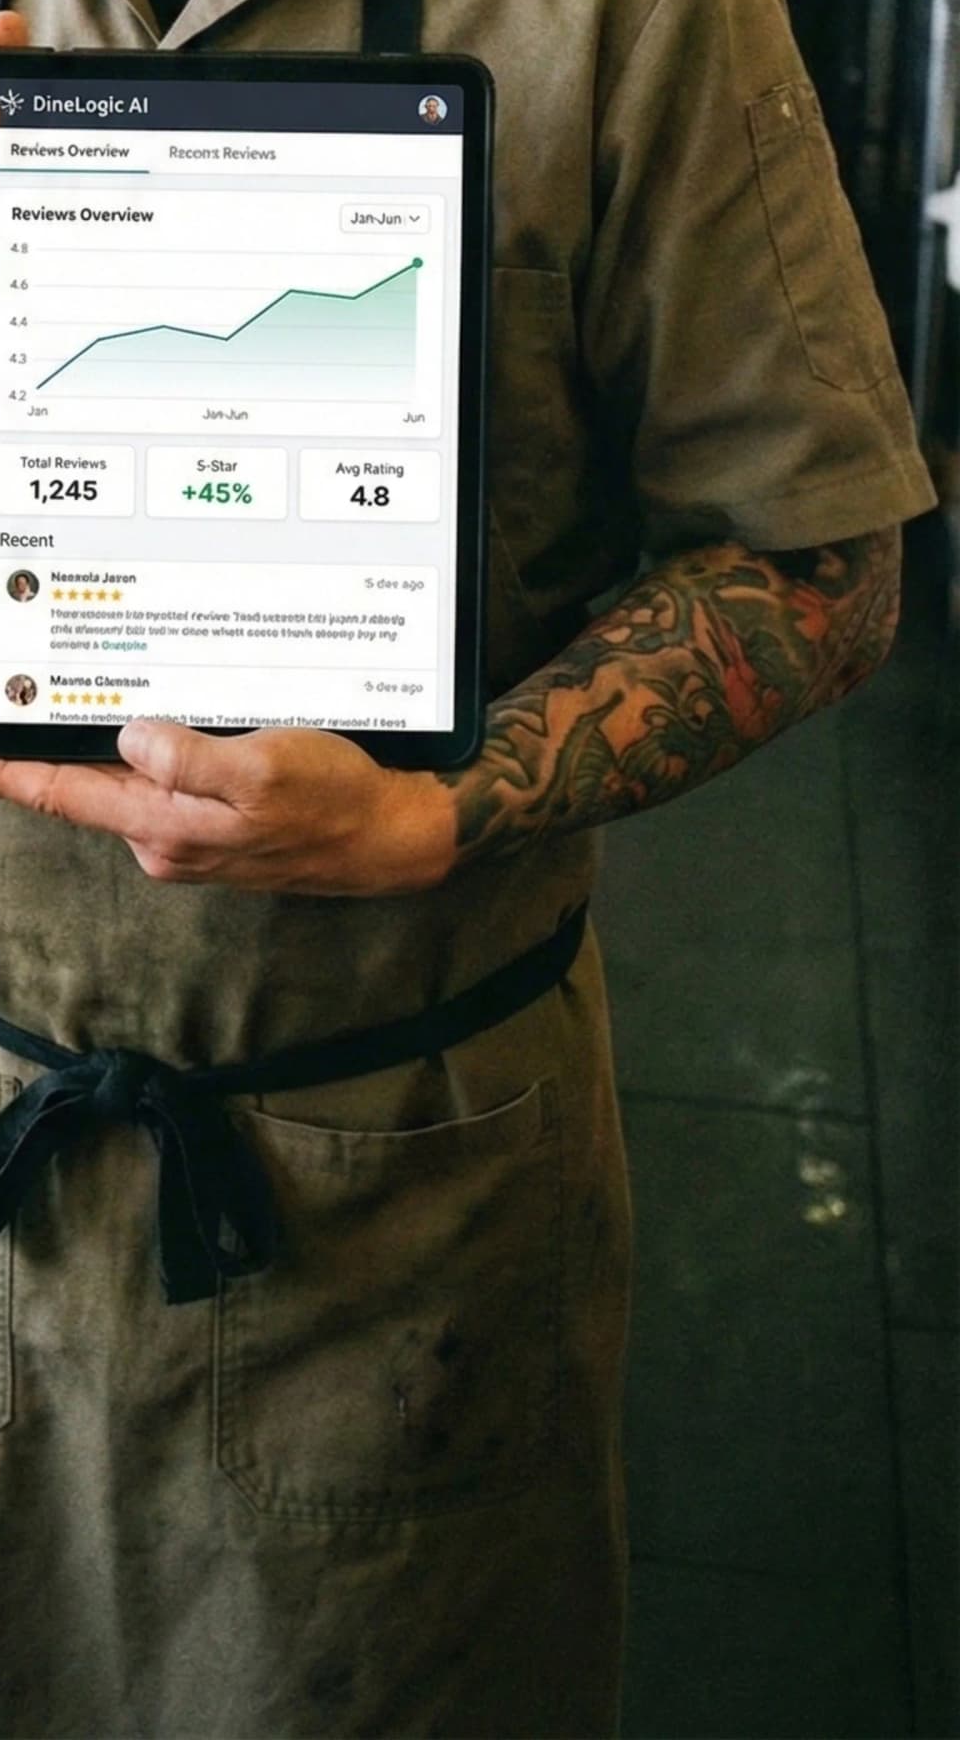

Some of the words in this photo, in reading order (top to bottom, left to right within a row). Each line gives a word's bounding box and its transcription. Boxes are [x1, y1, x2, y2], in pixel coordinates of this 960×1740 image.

[33, 95, 125, 118] DineLogic
[128, 96, 149, 114] AI
[10, 142, 66, 158] Reviews
[67, 143, 131, 158] Overview
[222, 145, 277, 161] Reviews
[11, 205, 77, 222] Reviews
[79, 206, 155, 223] Overview
[26, 405, 49, 417] Jan
[402, 411, 426, 424] Jun
[19, 455, 52, 470] Total
[54, 456, 108, 471] Reviews
[335, 461, 361, 478] Avg
[363, 462, 405, 479] Rating
[29, 479, 98, 505] 1,245
[181, 481, 253, 505] +45%
[349, 485, 391, 507] 4.8
[0, 531, 55, 549] Recent
